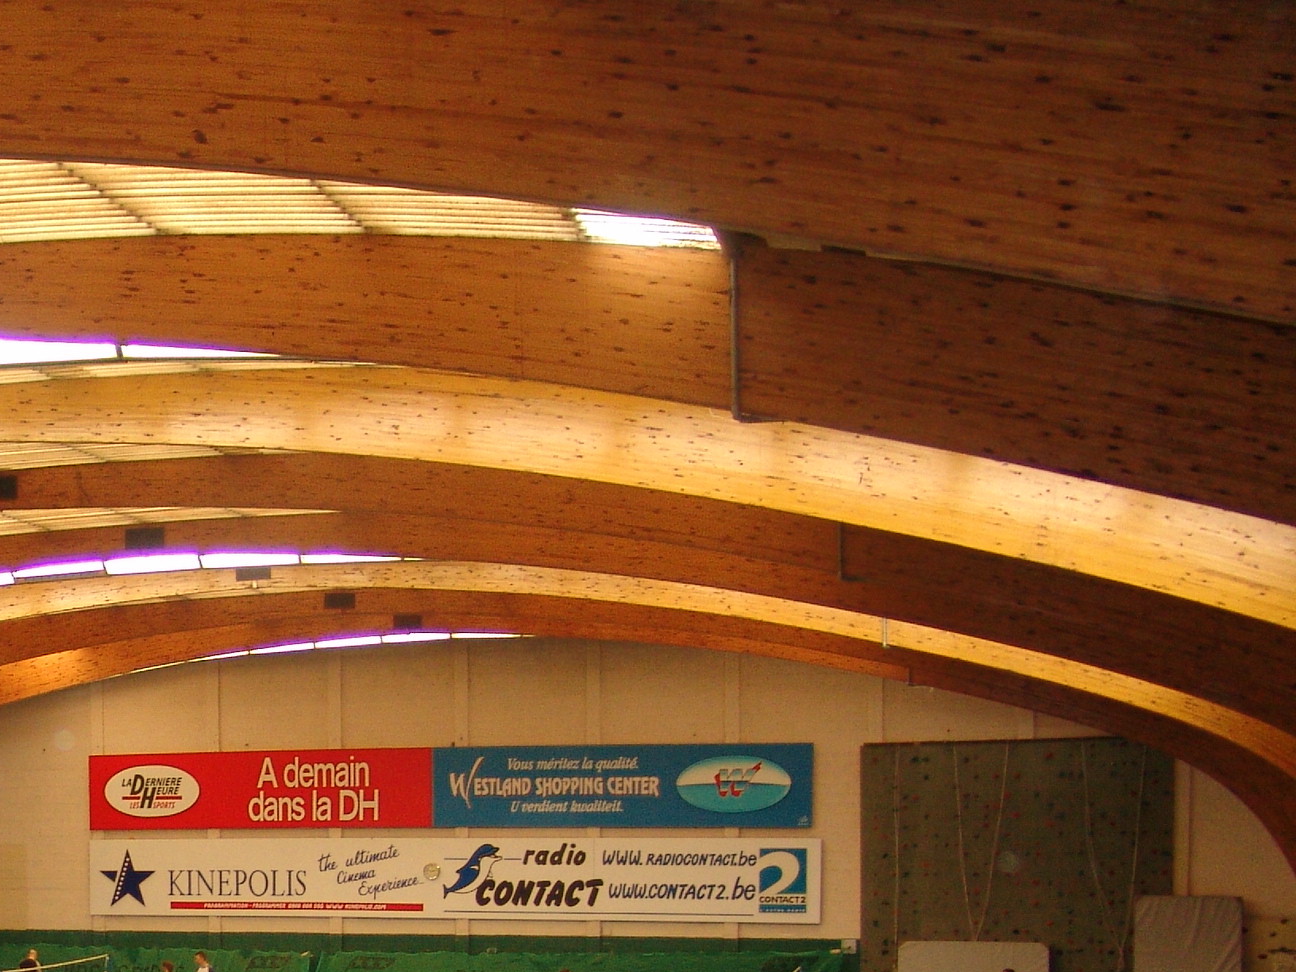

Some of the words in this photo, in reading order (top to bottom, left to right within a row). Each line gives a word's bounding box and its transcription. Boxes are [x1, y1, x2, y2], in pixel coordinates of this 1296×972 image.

[256, 756, 279, 789] A
[283, 755, 370, 788] demain
[507, 757, 534, 770] Vous
[537, 756, 580, 770] méritez
[582, 756, 594, 770] la
[122, 778, 132, 787] LA
[130, 774, 183, 795] DERNIERE
[449, 756, 532, 809] WESTLAND
[535, 776, 604, 797] SHOPPING
[607, 776, 660, 797] CENTER
[140, 786, 180, 808] HEURE
[248, 790, 306, 822] dans
[312, 789, 332, 822] la
[339, 788, 380, 821] DH
[510, 801, 520, 813] U
[522, 801, 567, 813] verdient
[318, 853, 338, 872] the
[345, 844, 400, 867] ultimate
[523, 843, 586, 866] radio
[167, 869, 307, 897] KINEPOLIS
[337, 869, 376, 885] Cinema
[475, 878, 603, 906] CONTACT
